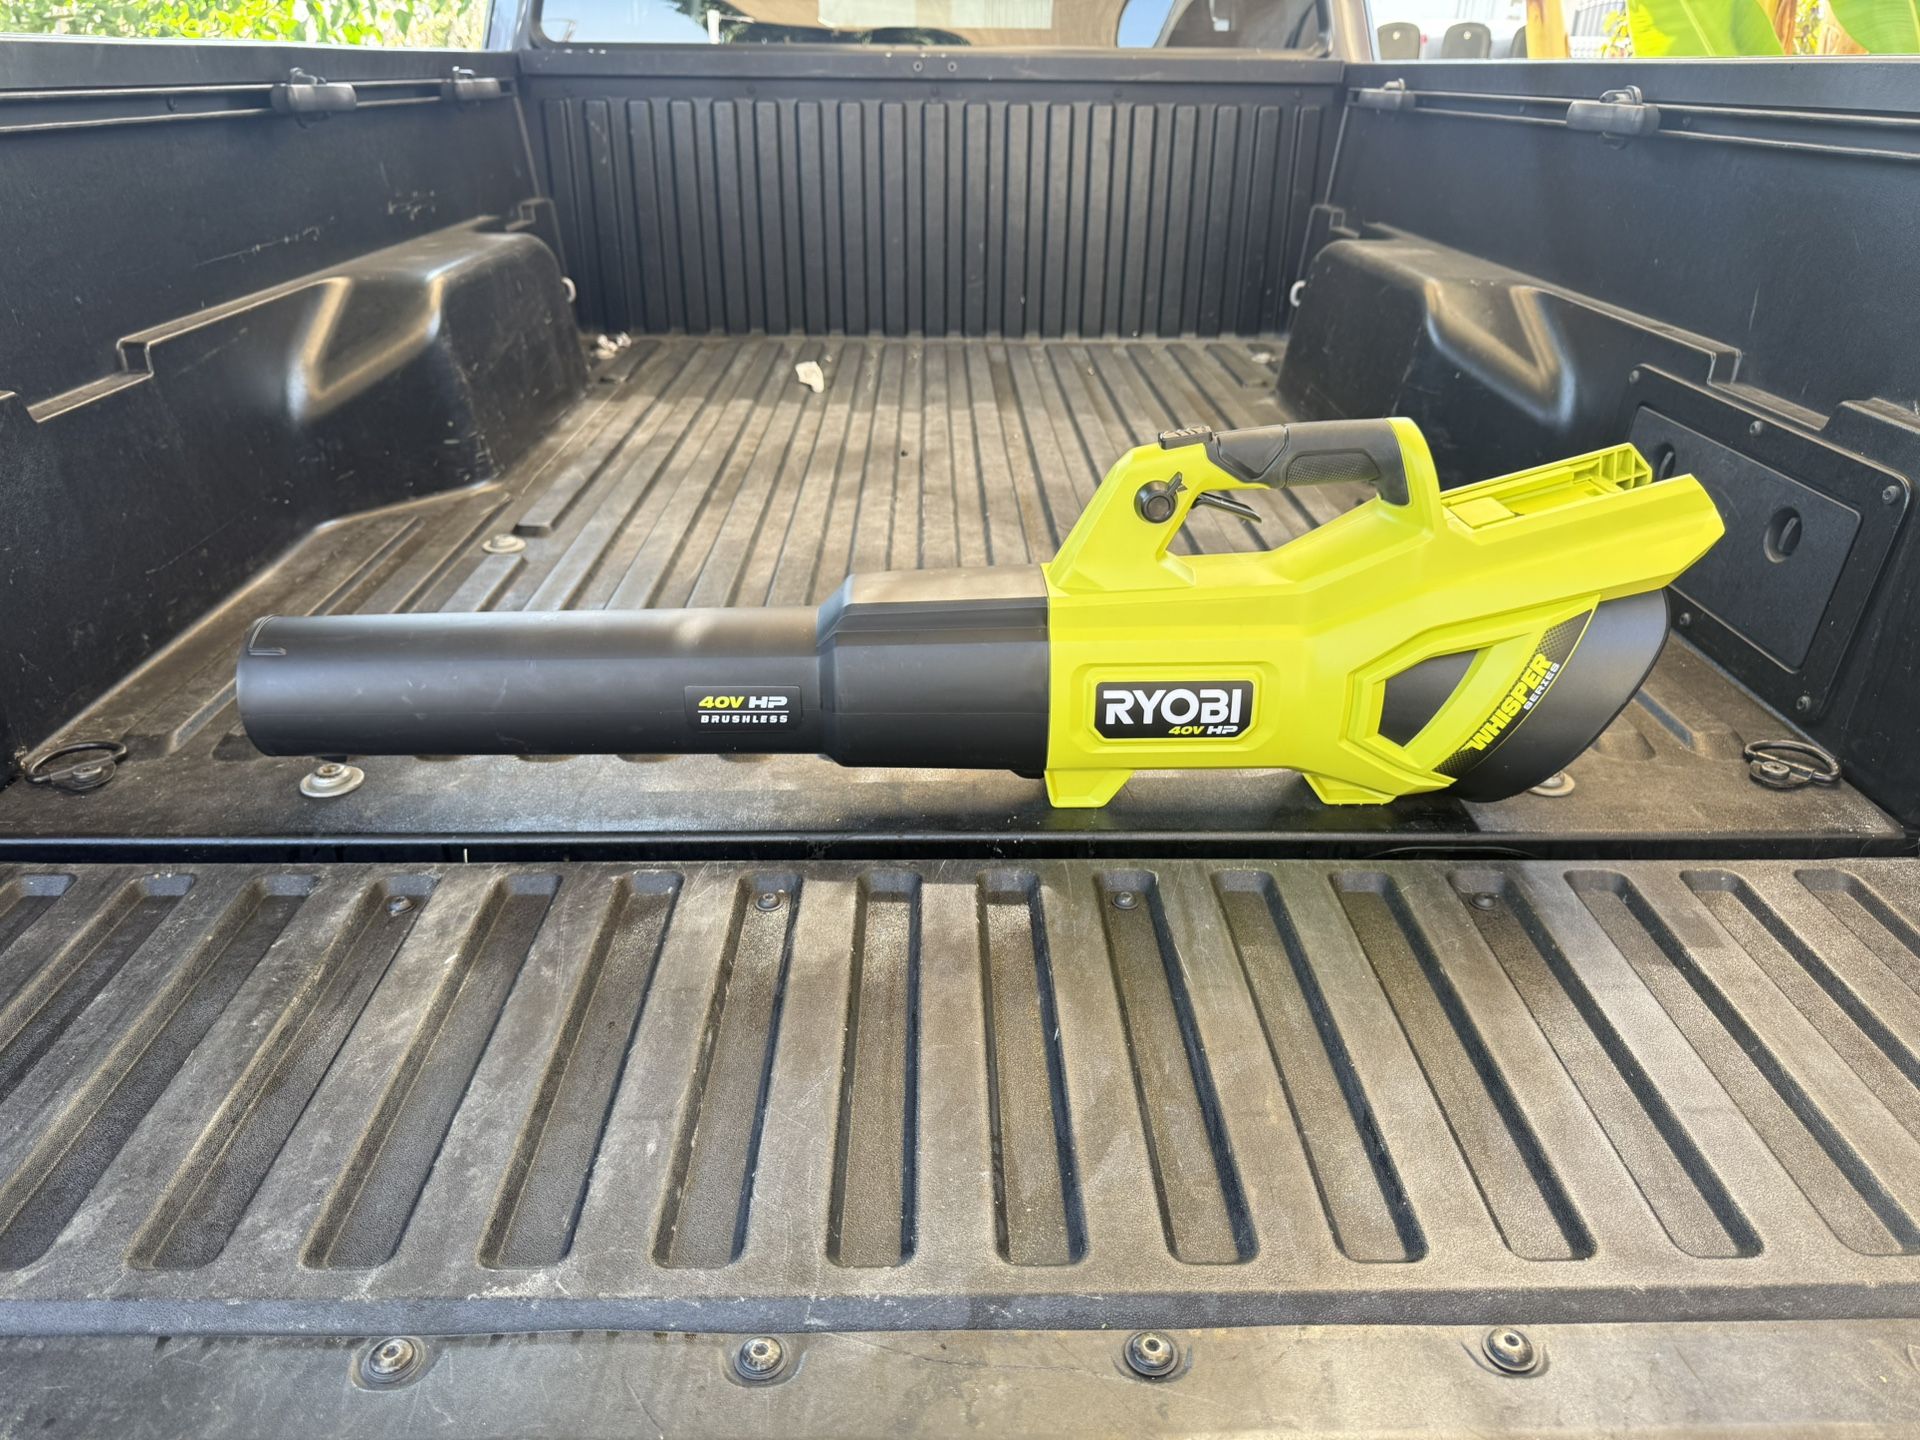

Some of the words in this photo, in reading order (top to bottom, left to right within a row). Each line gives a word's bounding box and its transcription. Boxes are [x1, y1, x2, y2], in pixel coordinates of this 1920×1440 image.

[1523, 662, 1560, 711] SERIES
[698, 696, 745, 709] 40V
[748, 696, 788, 709] HP
[1103, 688, 1242, 725] RYOBI
[1460, 653, 1553, 751] WHISPER
[700, 715, 788, 724] BRUSHLESS
[1168, 726, 1204, 735] 40V
[1206, 725, 1238, 735] HP
